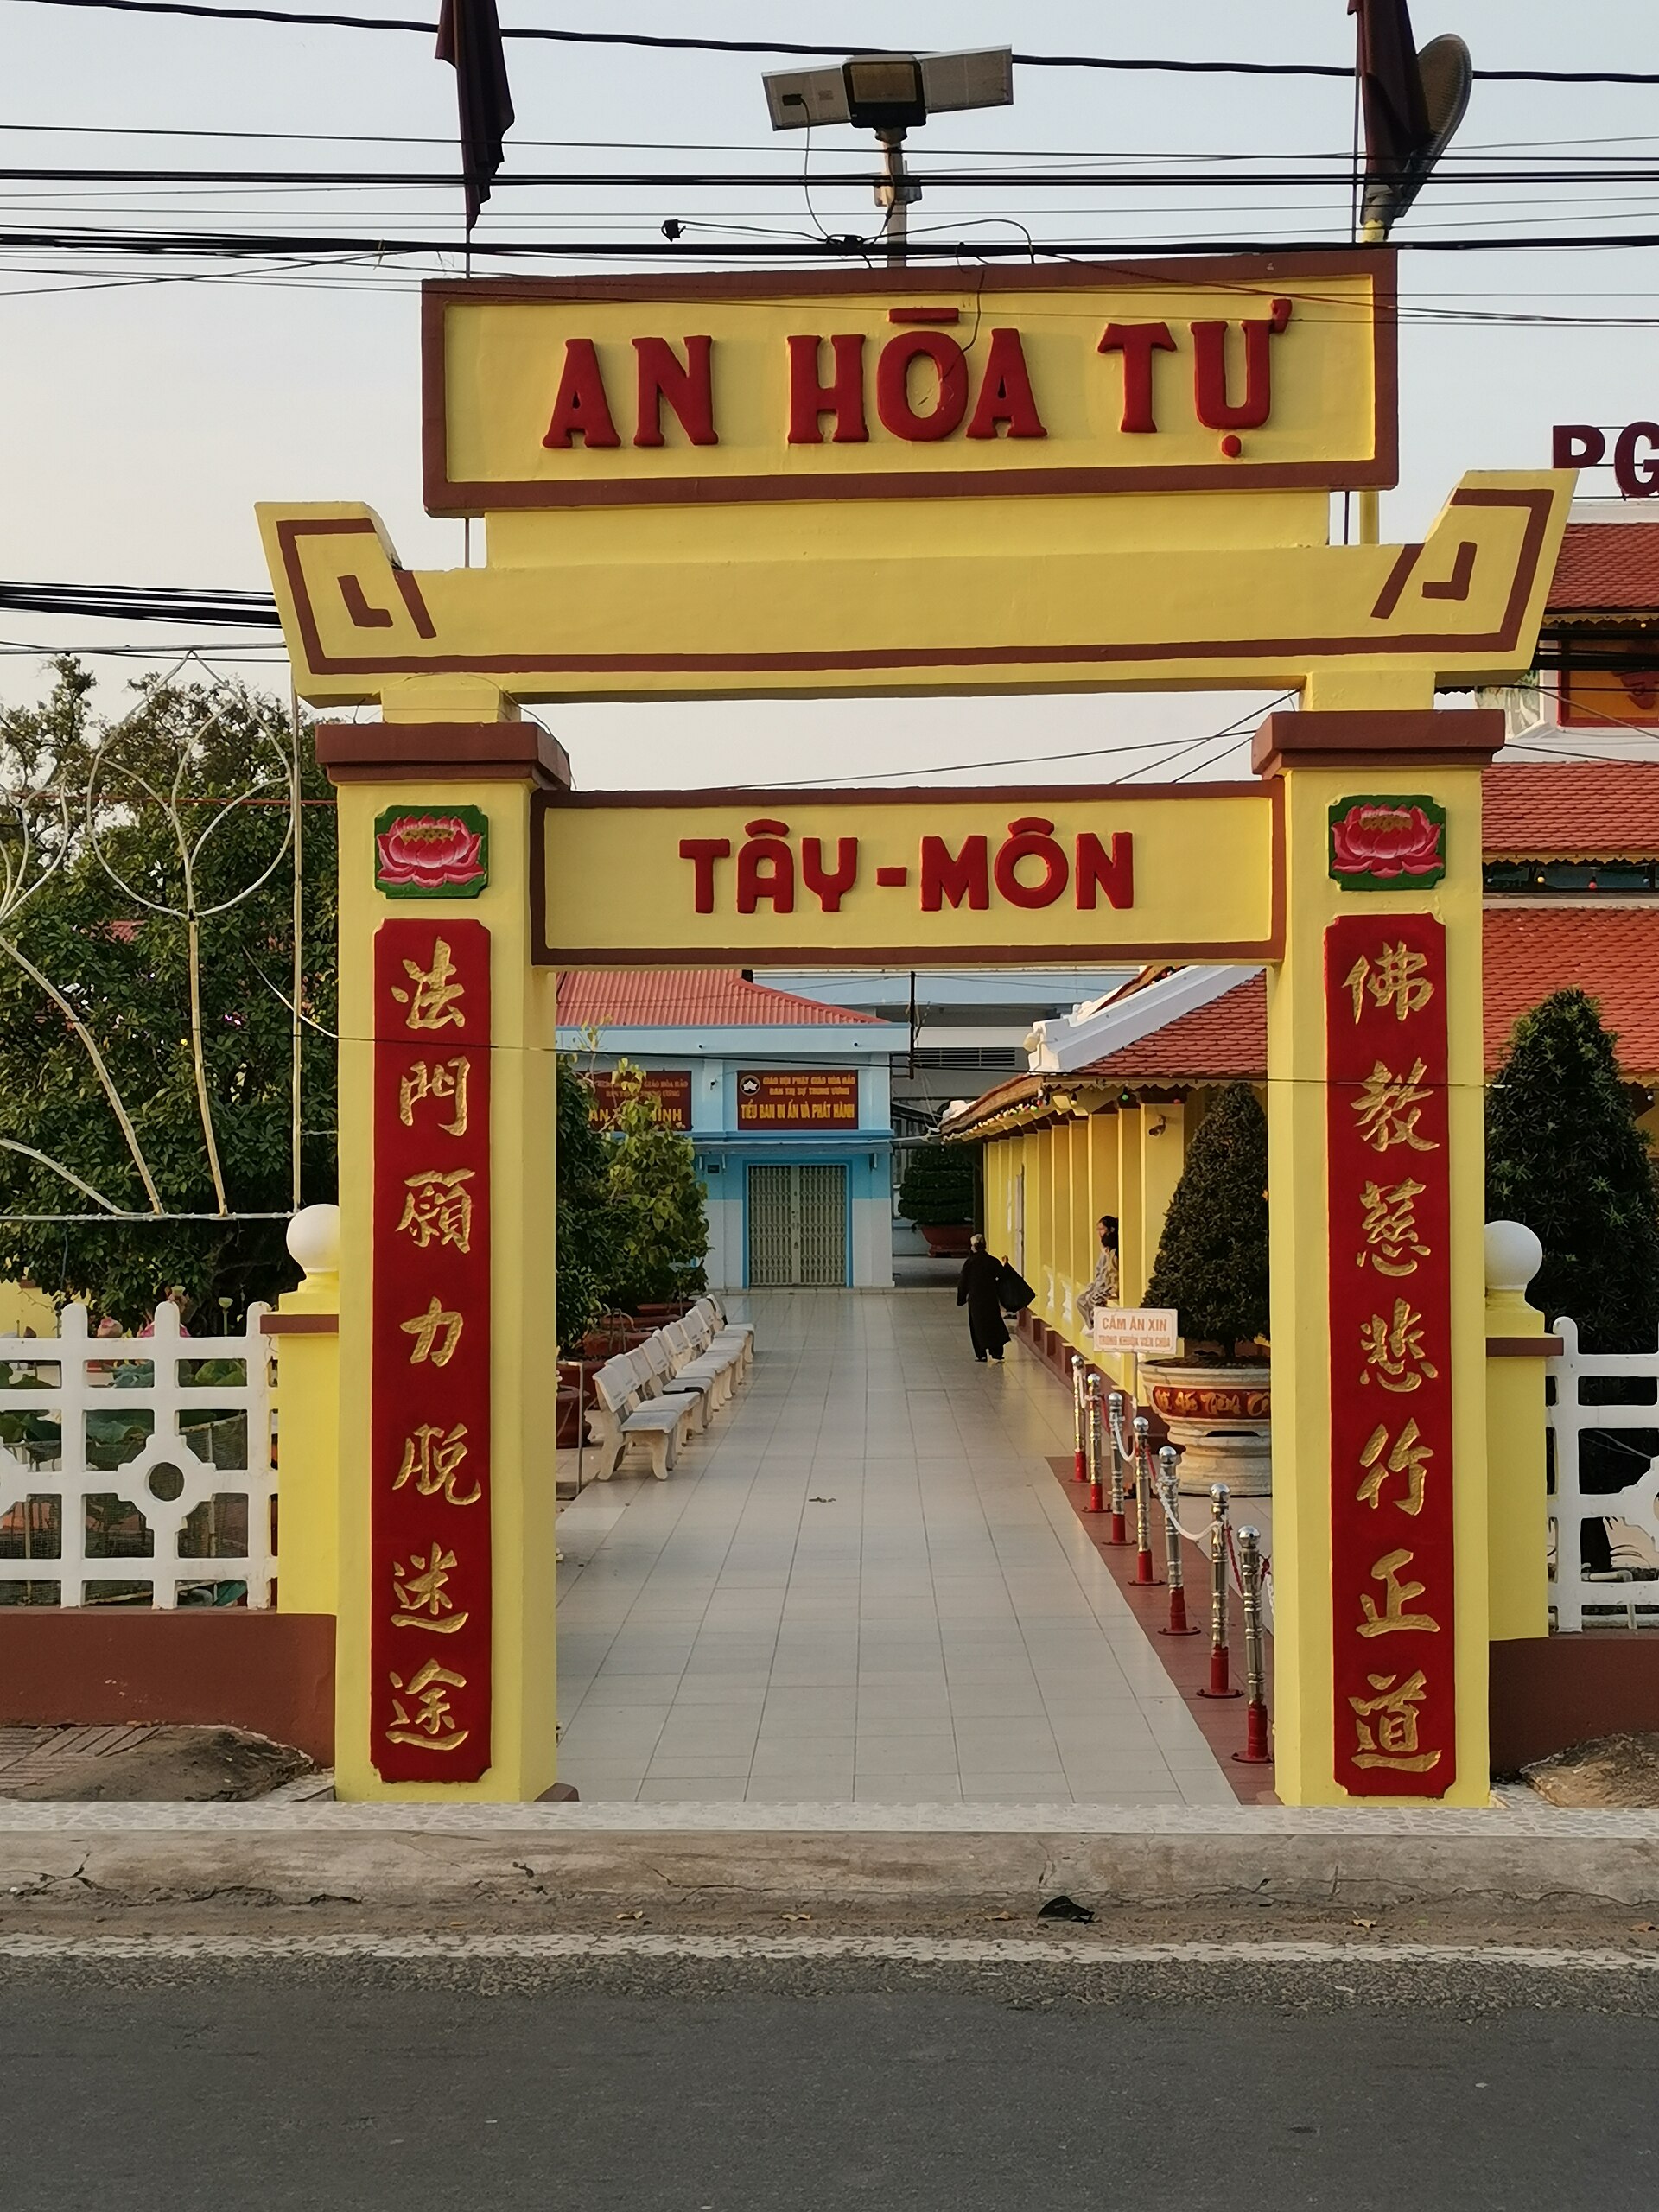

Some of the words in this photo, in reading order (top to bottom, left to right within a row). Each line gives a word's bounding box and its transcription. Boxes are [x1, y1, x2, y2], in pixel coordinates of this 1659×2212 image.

[542, 336, 718, 448] AN
[1097, 298, 1289, 457] TỰ
[759, 1103, 775, 1118] BAN
[811, 1100, 831, 1118] PHÁT
[1148, 1319, 1167, 1332] XIN
